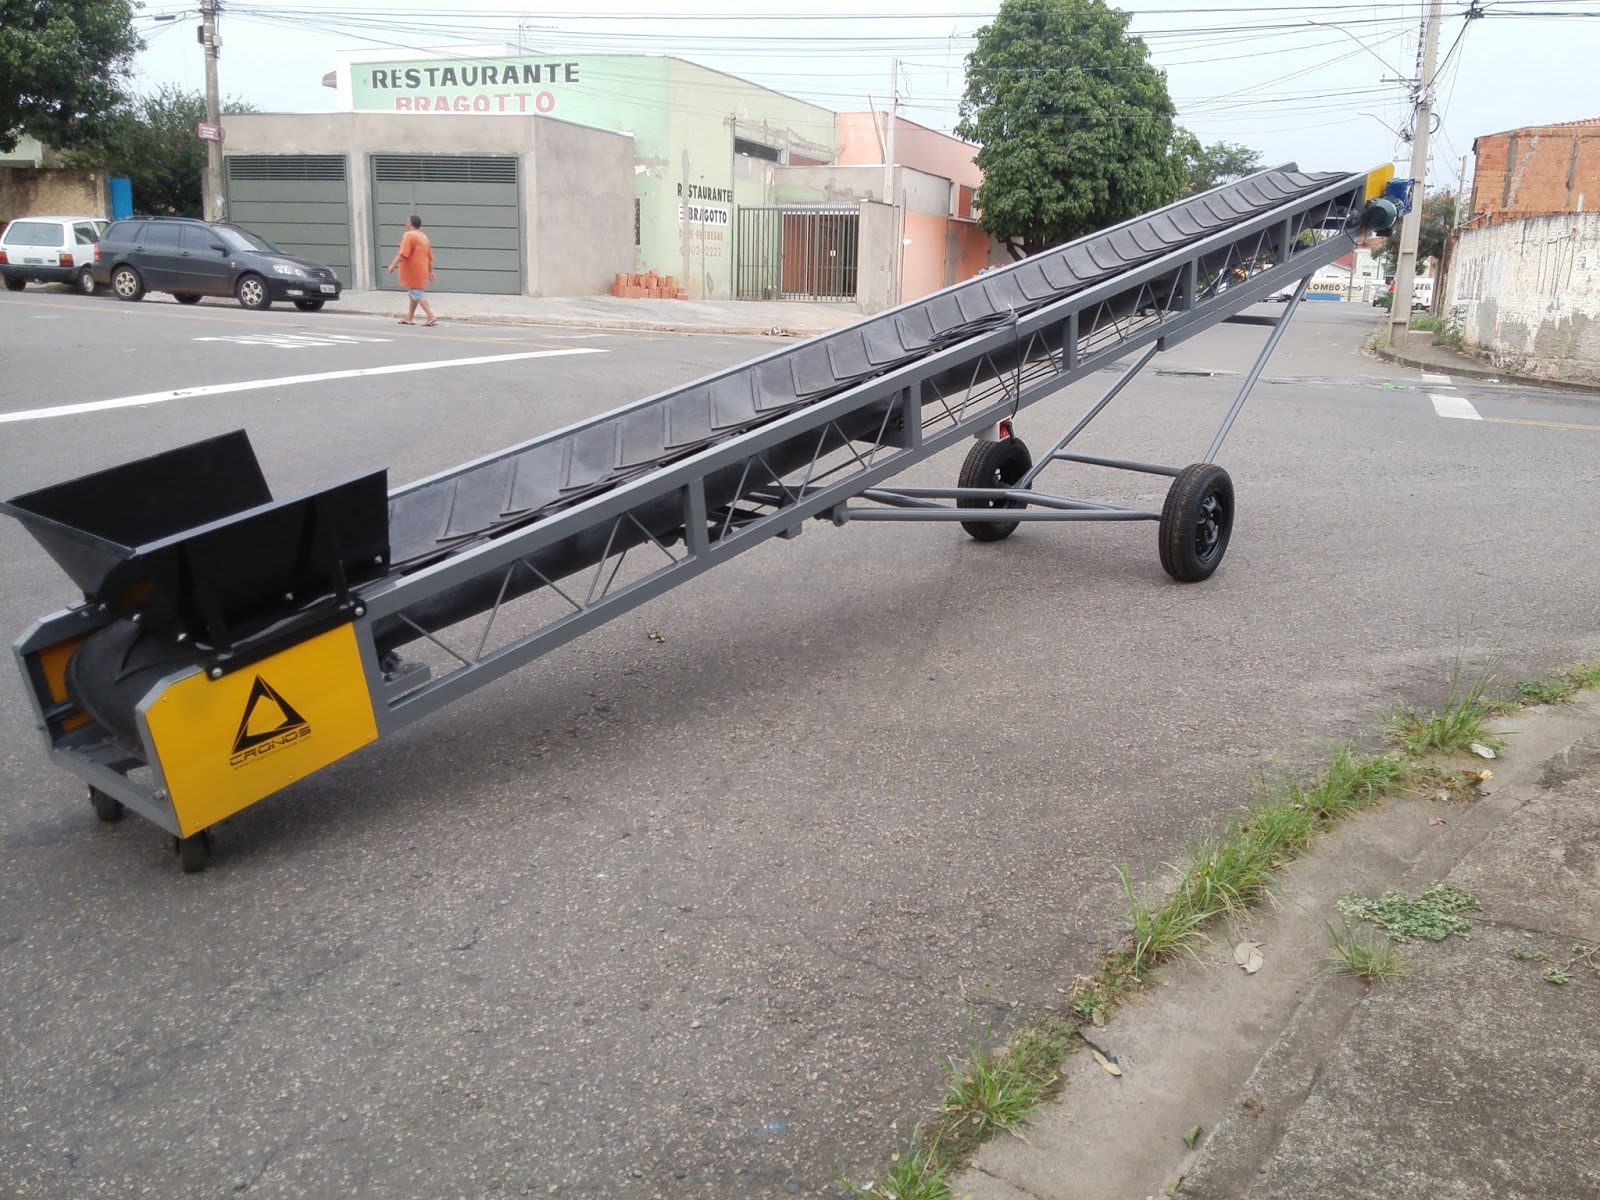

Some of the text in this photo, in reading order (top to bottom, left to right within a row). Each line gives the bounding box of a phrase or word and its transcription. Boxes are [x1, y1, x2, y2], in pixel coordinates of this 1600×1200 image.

[371, 62, 580, 89] RESTAURANTE
[395, 91, 555, 113] BRAGOTTO
[677, 182, 733, 204] RSTAURANTE
[228, 725, 312, 767] CRONOS
